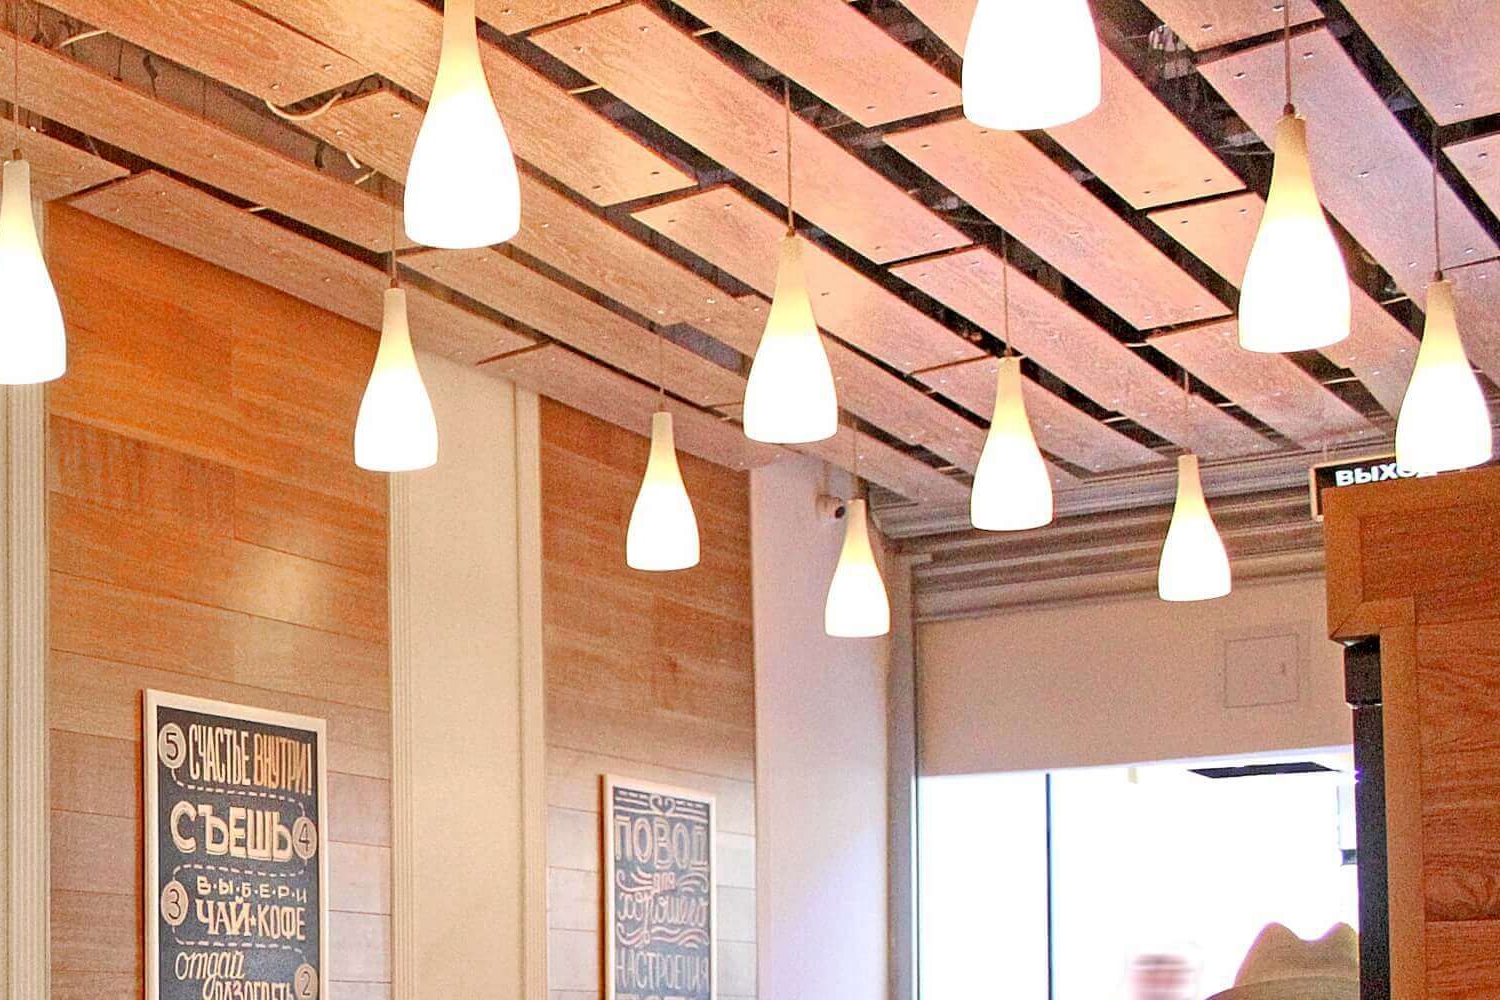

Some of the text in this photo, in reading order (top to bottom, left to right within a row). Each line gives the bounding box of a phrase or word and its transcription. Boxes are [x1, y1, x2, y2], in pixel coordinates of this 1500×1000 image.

[1335, 462, 1438, 487] ВЫХ
[165, 732, 179, 761] 5
[188, 723, 313, 796] СЧАСТЬЕ ВНУТРИ!
[170, 800, 293, 863] СЪЕШЬ
[298, 822, 311, 852] 4
[615, 815, 709, 871] ПОВОД
[168, 888, 181, 920] 3
[257, 903, 307, 941] КОФЕ
